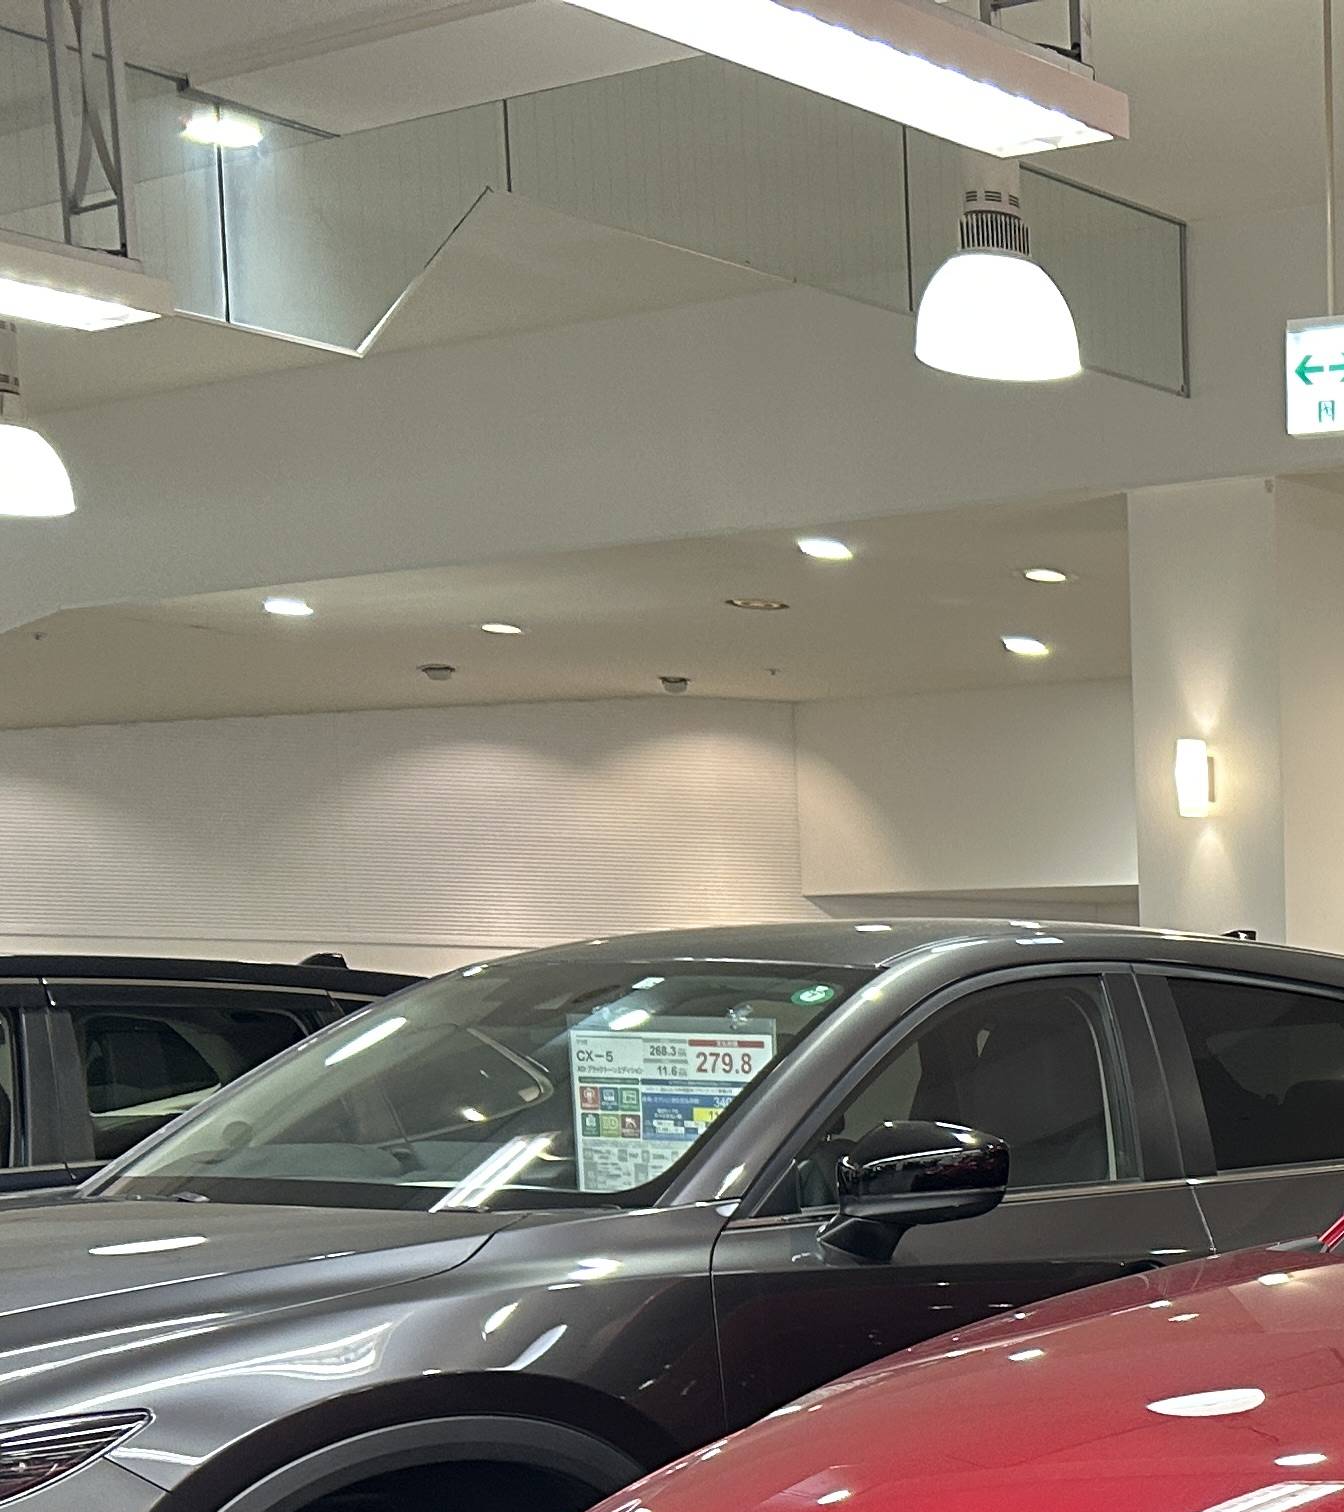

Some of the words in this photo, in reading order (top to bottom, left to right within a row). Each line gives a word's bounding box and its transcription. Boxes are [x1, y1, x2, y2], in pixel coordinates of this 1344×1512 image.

[650, 1045, 677, 1056] 268.3
[696, 1052, 752, 1074] 279.8
[657, 1066, 678, 1076] 11.6
